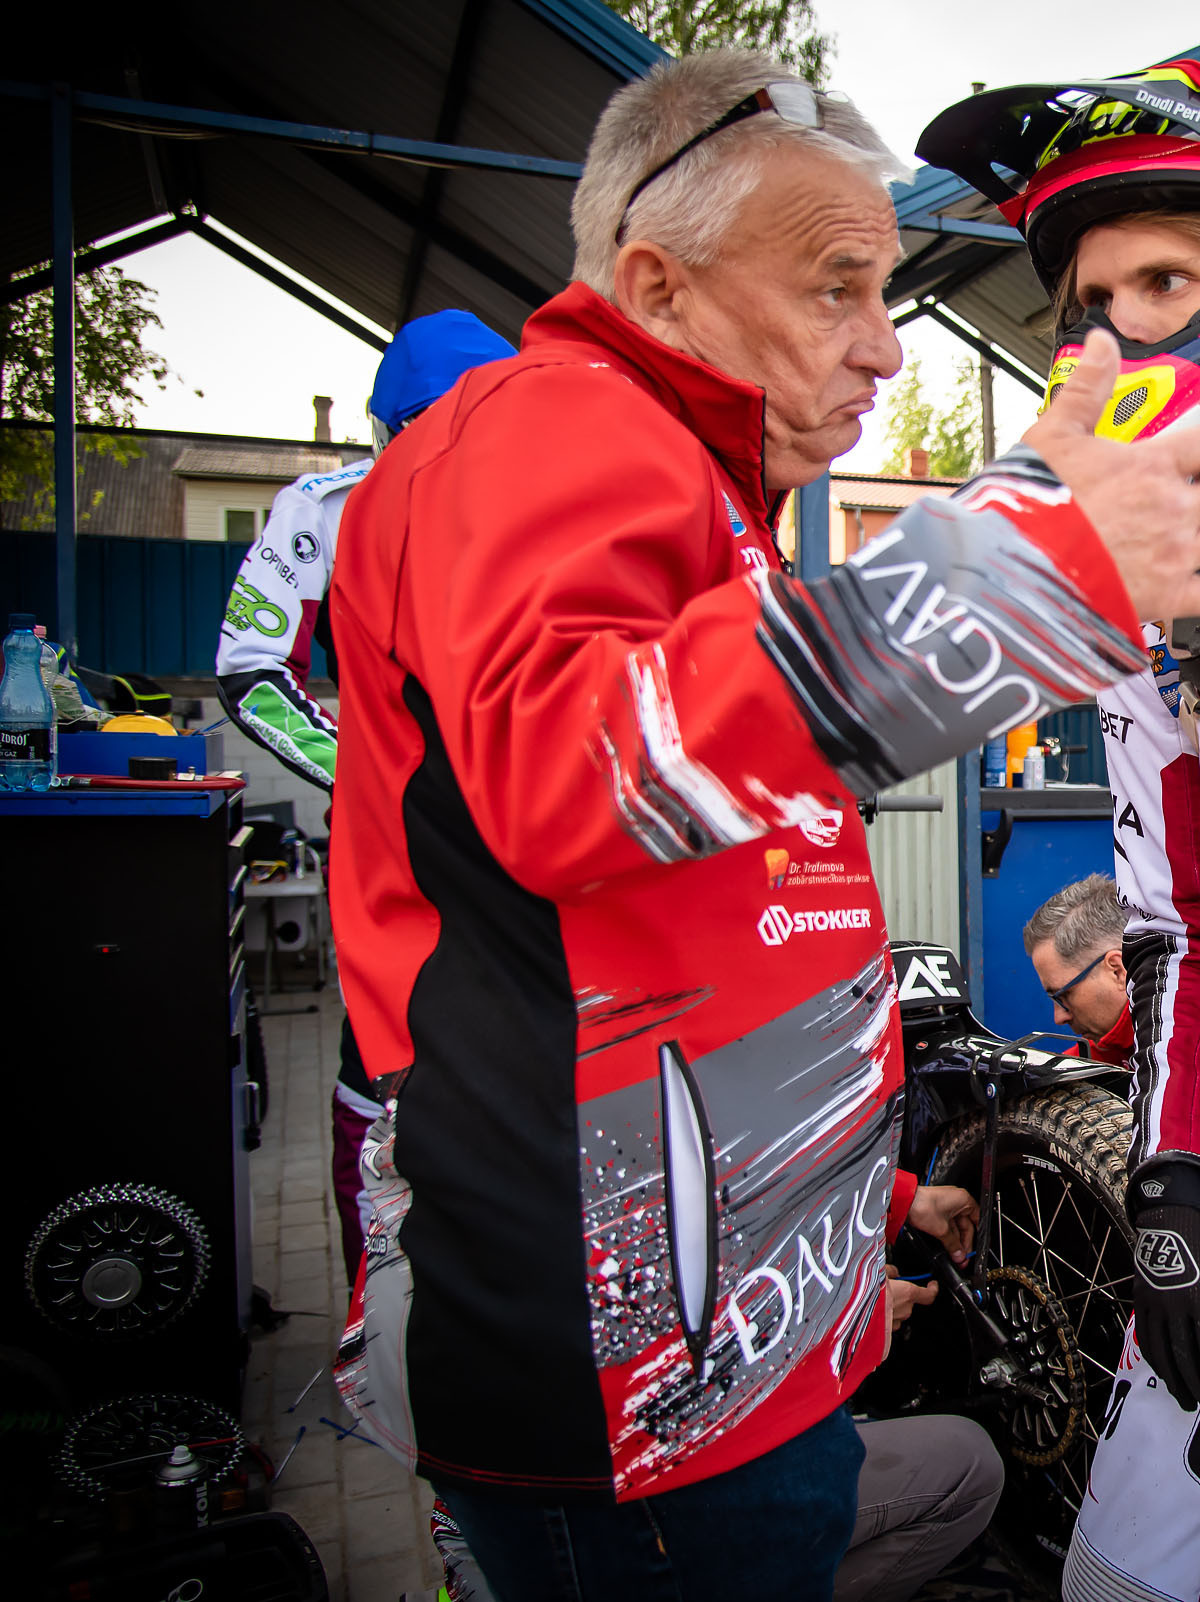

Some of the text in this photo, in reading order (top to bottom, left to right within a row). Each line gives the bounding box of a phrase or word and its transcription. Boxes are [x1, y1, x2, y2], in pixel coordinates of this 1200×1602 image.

[1136, 89, 1174, 113] Drudi
[793, 908, 872, 933] STOKKER
[1049, 1142, 1092, 1184] ANLAS
